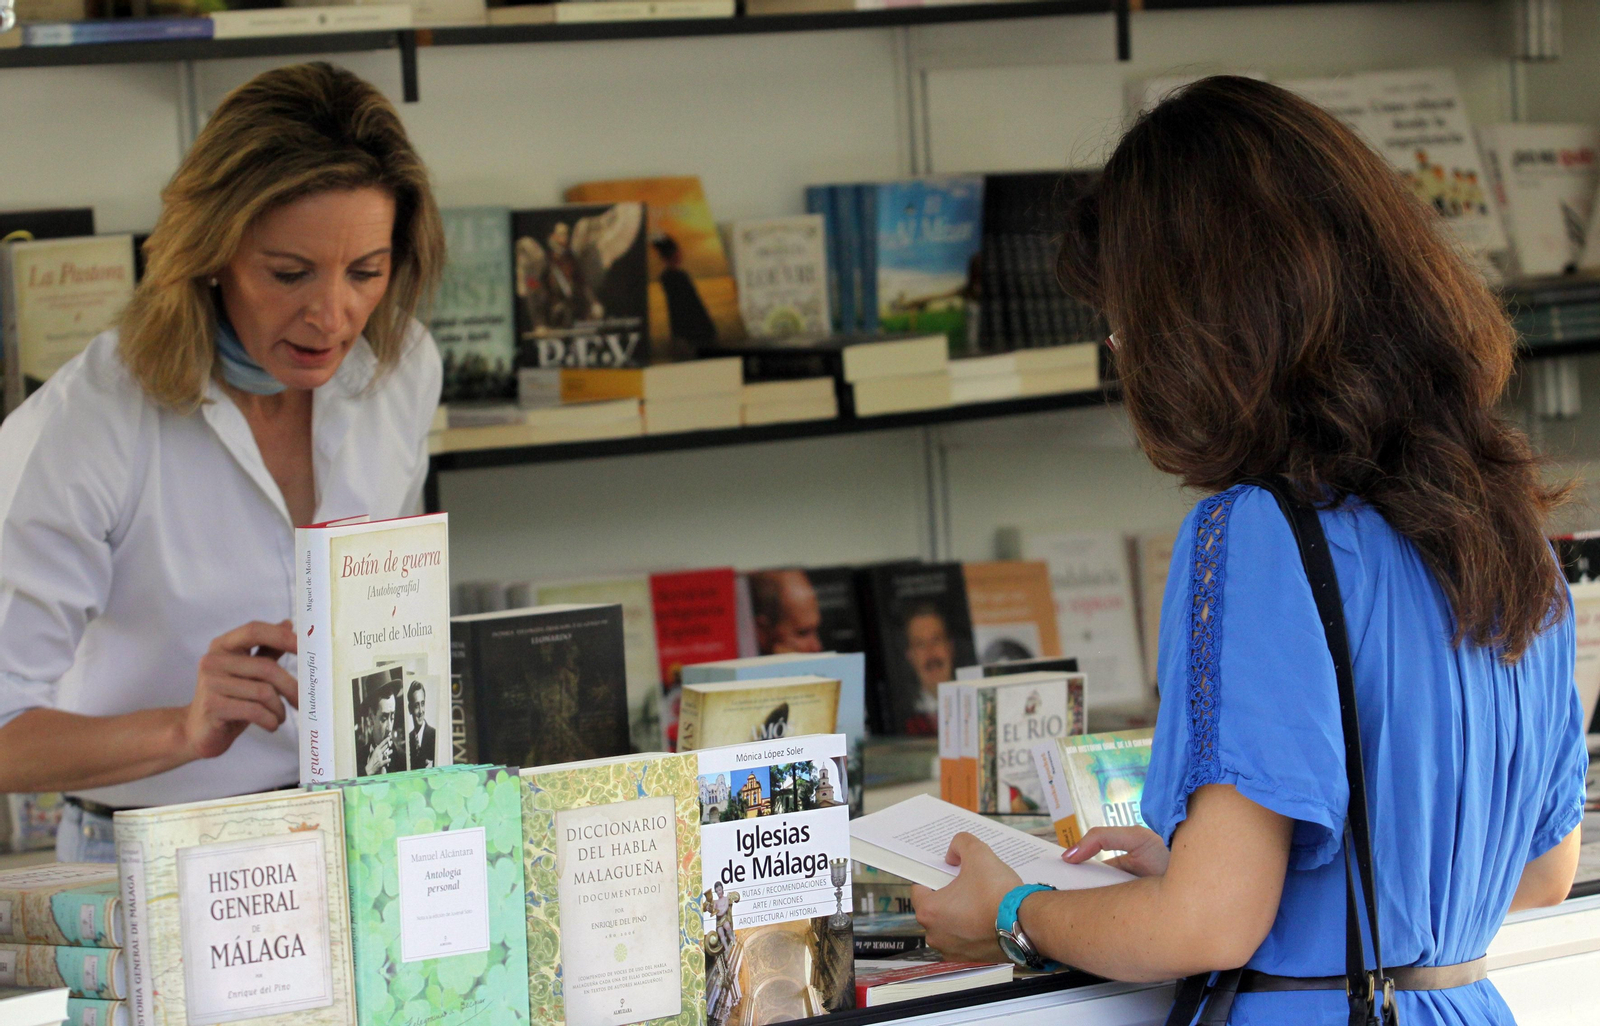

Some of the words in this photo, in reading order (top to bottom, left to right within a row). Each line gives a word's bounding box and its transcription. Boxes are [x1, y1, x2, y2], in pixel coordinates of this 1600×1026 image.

[341, 553, 380, 578] Botín
[384, 550, 398, 573] de
[401, 550, 441, 578] guerra
[306, 576, 312, 586] de
[367, 579, 420, 600] [Autobiografía]
[306, 588, 314, 612] Miguel
[353, 627, 386, 649] Miguel
[389, 626, 400, 641] de
[402, 622, 433, 639] Molina
[1003, 722, 1021, 743] EL
[1027, 714, 1063, 740] RÍO
[310, 729, 325, 776] guerra
[735, 752, 763, 762] Mónica
[763, 749, 785, 760] López
[786, 746, 804, 756] Soler
[1101, 801, 1143, 827] GUE
[566, 815, 667, 842] DICCIONARIO
[736, 821, 811, 858] Iglesias
[410, 850, 438, 863] Manuel
[439, 848, 474, 860] Alcántara
[578, 845, 606, 861] DEL
[611, 838, 658, 857] HABLA
[208, 863, 298, 893] HISTORIA
[424, 867, 462, 880] Antología
[573, 859, 664, 885] MALAGUEÑA
[720, 860, 746, 885] de
[752, 851, 829, 879] Málaga
[427, 880, 460, 897] personal
[578, 883, 661, 905] [DOCUMENTADO]
[742, 887, 762, 898] RUTAS
[766, 878, 827, 895] RECOMENDACIONES
[210, 889, 300, 921] GENERAL
[752, 900, 768, 910] ARTE
[773, 896, 804, 907] RINCONES
[131, 921, 139, 935] DE
[591, 919, 618, 930] ENRIQUE
[619, 917, 631, 926] DEL
[631, 914, 648, 924] PINO
[738, 910, 785, 926] ARQUITECTURA
[789, 907, 818, 918] HISTORIA
[252, 925, 261, 933] DE
[210, 933, 307, 970] MÁLAGA
[872, 941, 896, 950] PODER
[131, 938, 143, 985] GENERAL
[228, 988, 257, 999] Enrique
[260, 985, 272, 994] del
[273, 983, 291, 992] Pino
[135, 987, 146, 1026] ISTORIA
